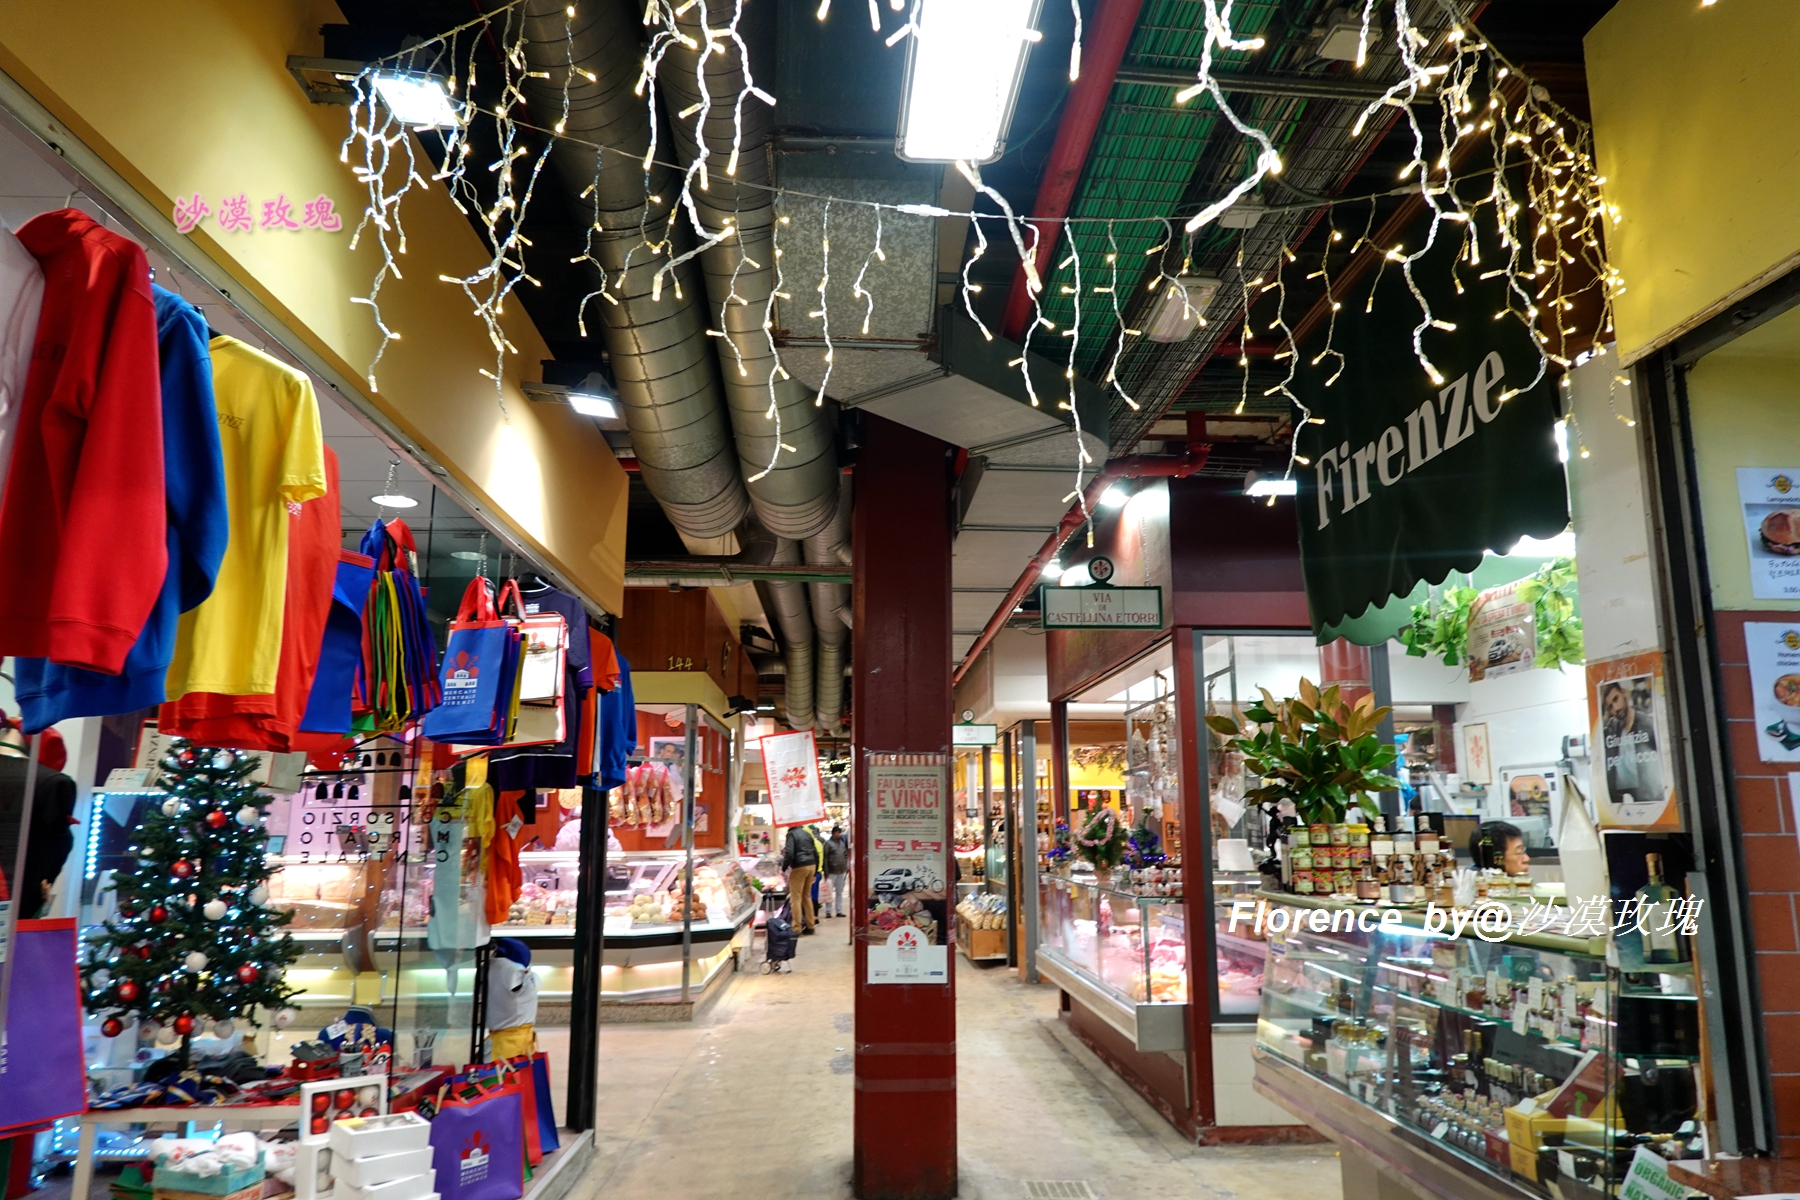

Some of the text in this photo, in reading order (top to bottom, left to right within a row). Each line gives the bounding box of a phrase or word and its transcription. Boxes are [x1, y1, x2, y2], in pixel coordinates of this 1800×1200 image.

[1314, 350, 1506, 532] Firenze
[1093, 592, 1112, 603] VIA
[1047, 612, 1160, 623] CASTELLINA E TORRI
[668, 655, 693, 671] 144
[769, 760, 781, 800] FIRENZE
[877, 778, 939, 789] FAI LA SPESA
[877, 789, 939, 808] E VINCI
[1633, 1161, 1686, 1200] ORGANIC
